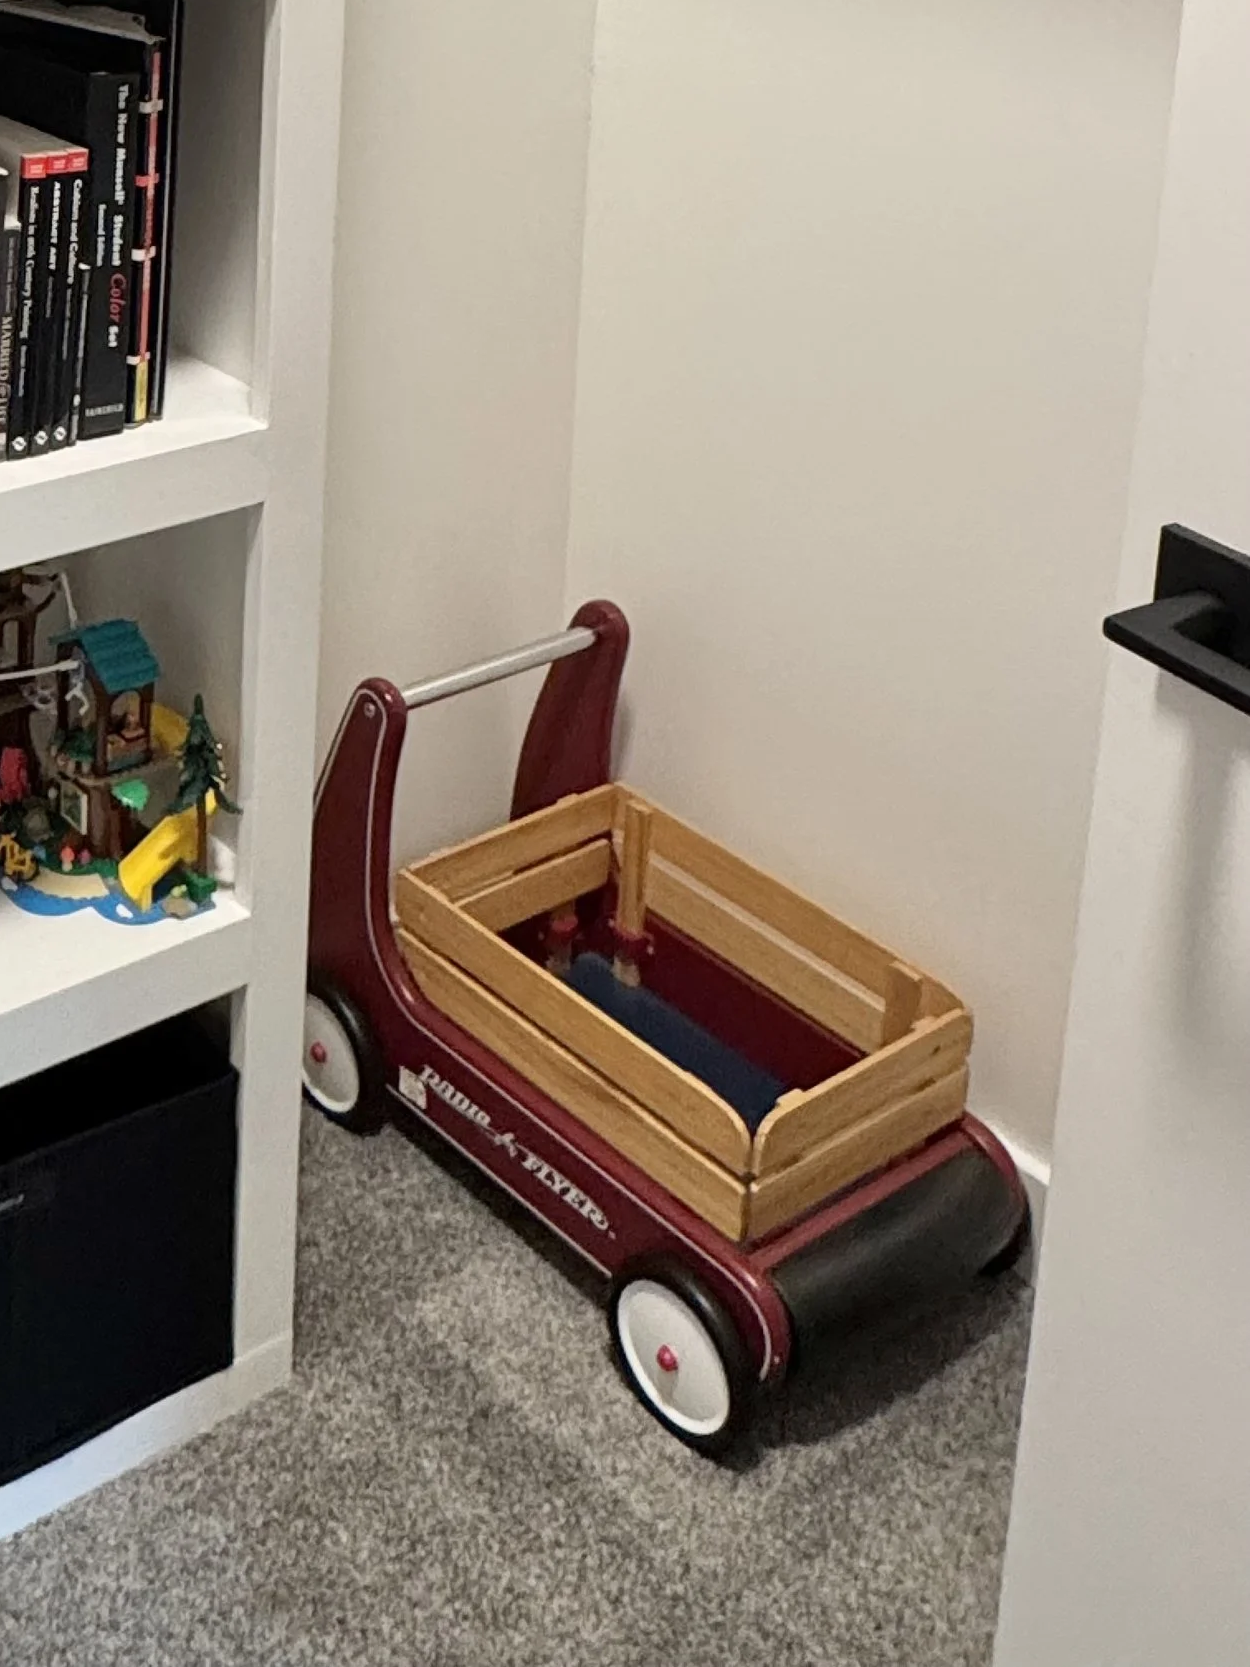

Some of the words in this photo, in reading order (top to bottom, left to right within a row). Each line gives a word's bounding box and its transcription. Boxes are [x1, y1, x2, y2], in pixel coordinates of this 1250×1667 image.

[117, 114, 129, 145] New
[111, 214, 124, 267] Student
[109, 272, 127, 323] Color
[107, 324, 120, 348] Set
